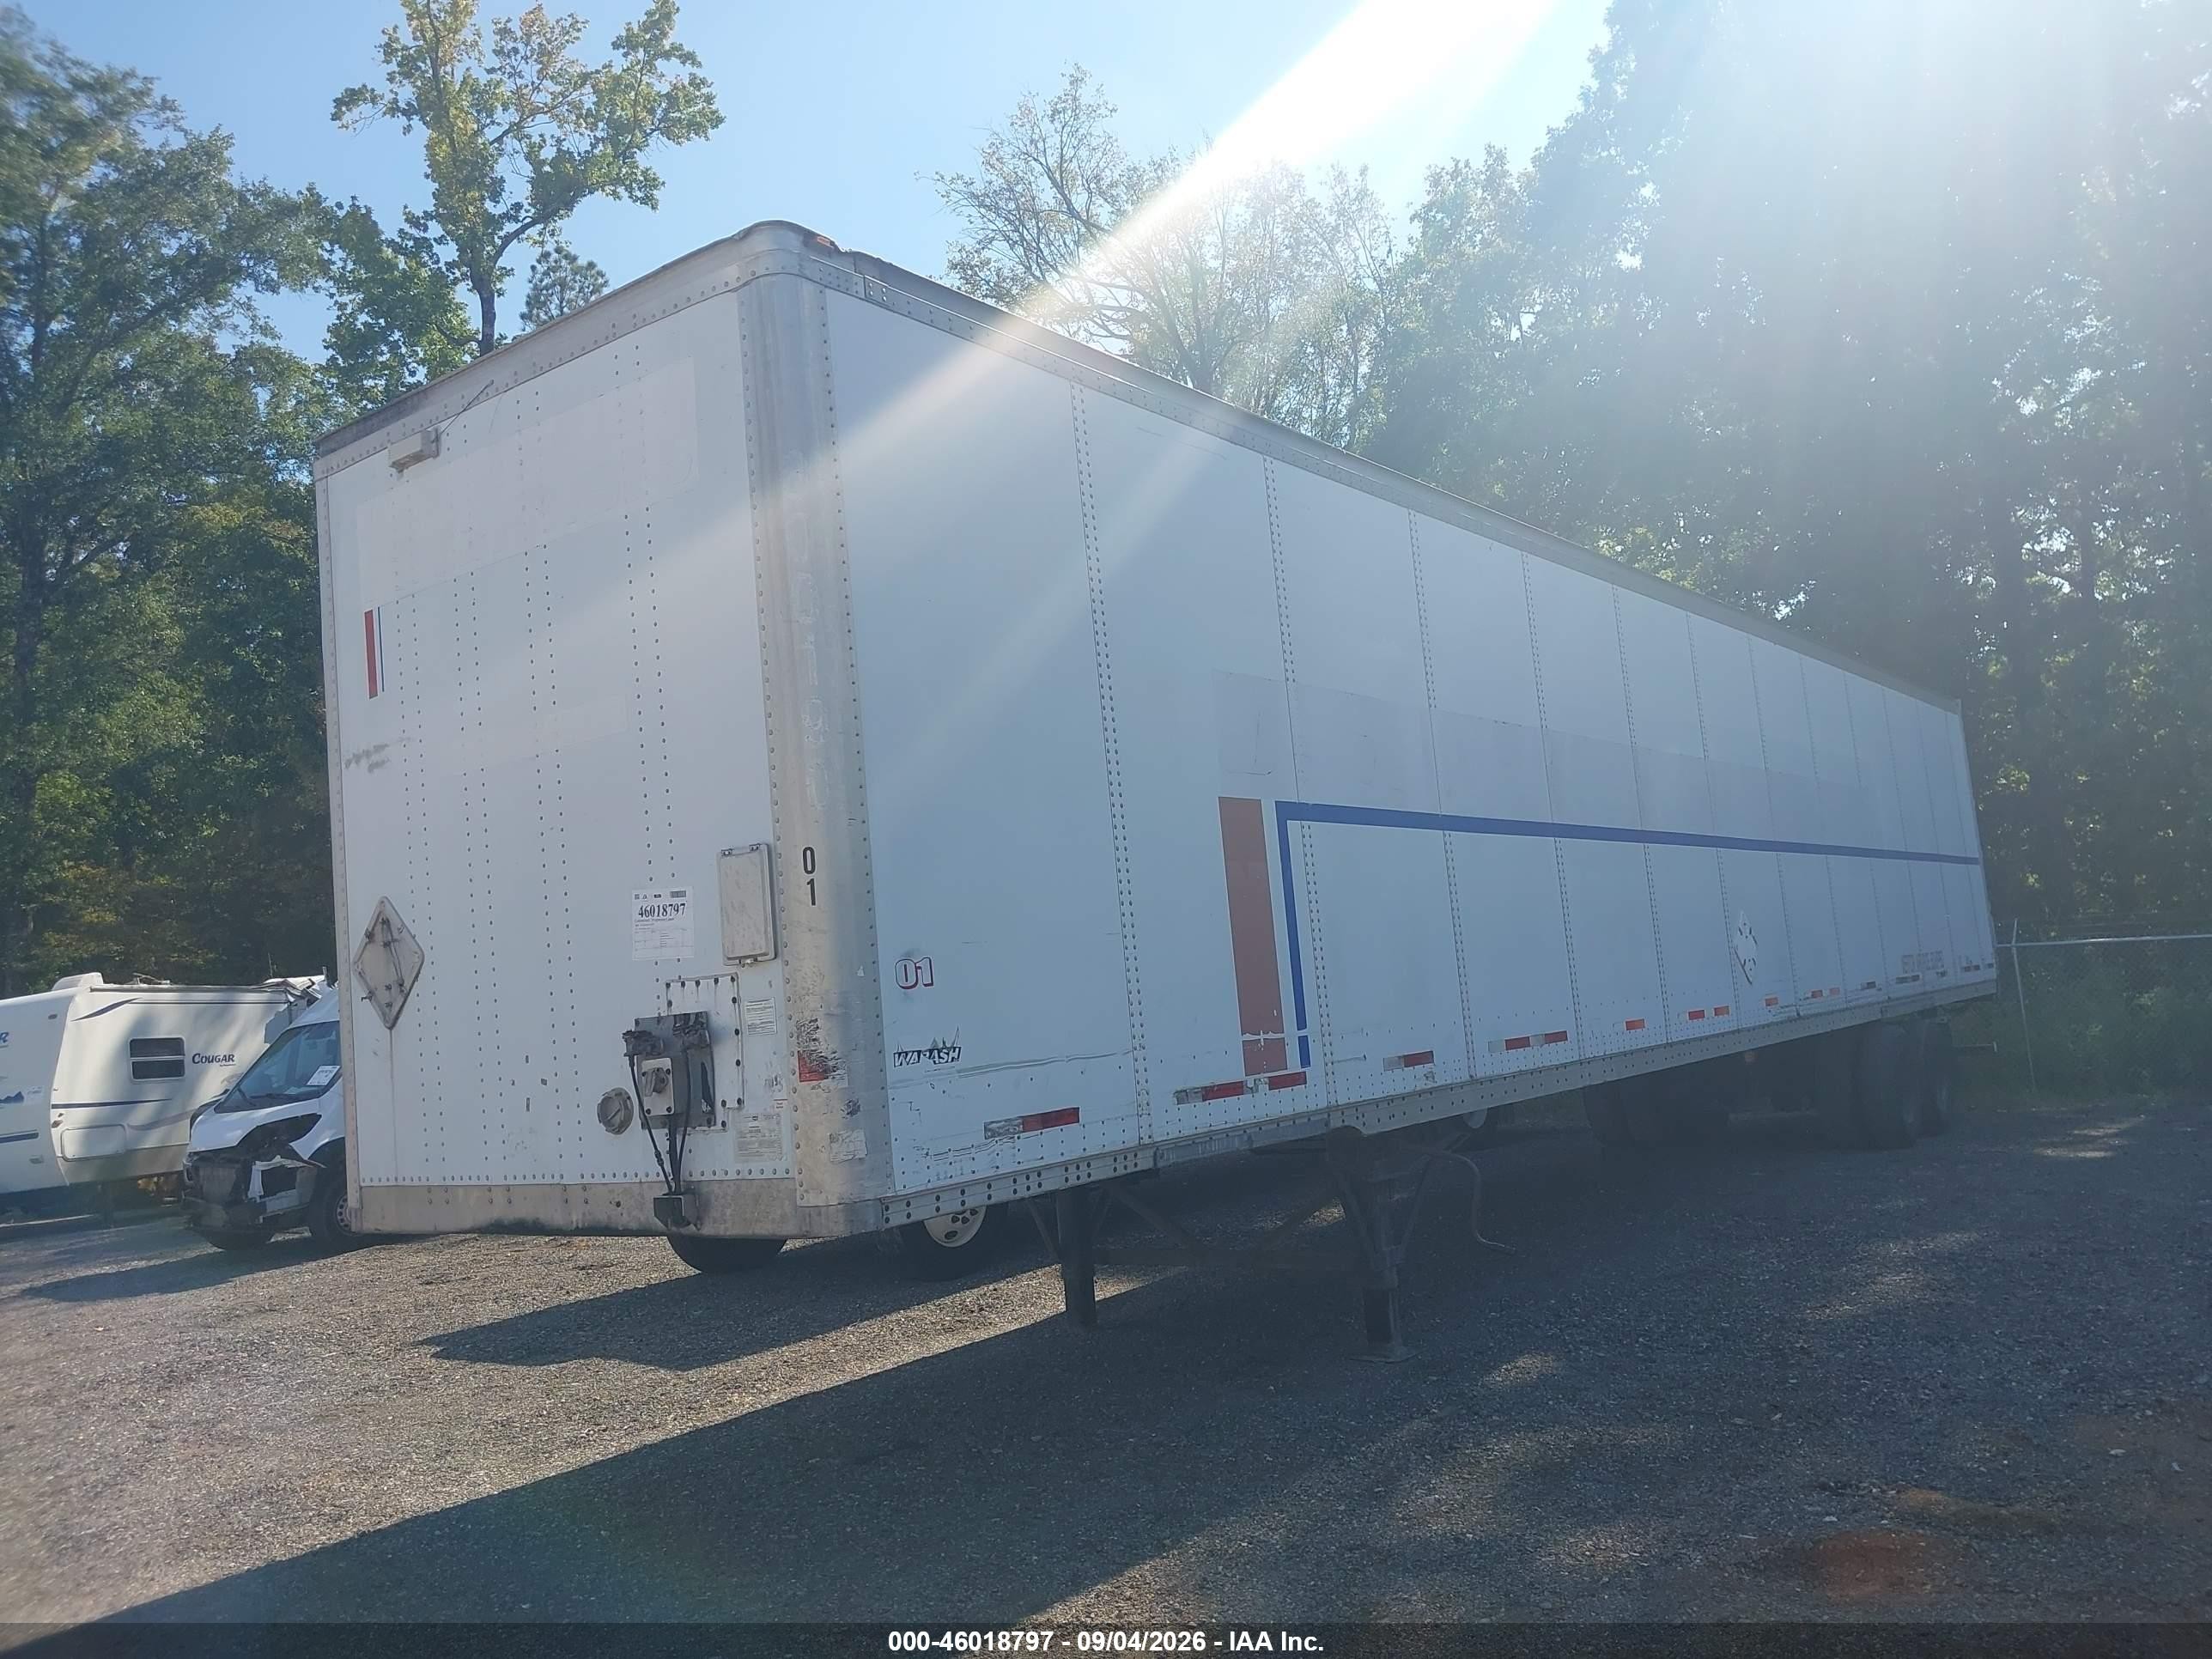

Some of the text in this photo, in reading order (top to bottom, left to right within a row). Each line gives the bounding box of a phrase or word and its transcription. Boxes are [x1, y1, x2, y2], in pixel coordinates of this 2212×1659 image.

[638, 902, 686, 918] 46018797
[895, 957, 934, 989] 01
[191, 1053, 235, 1064] COUGAR
